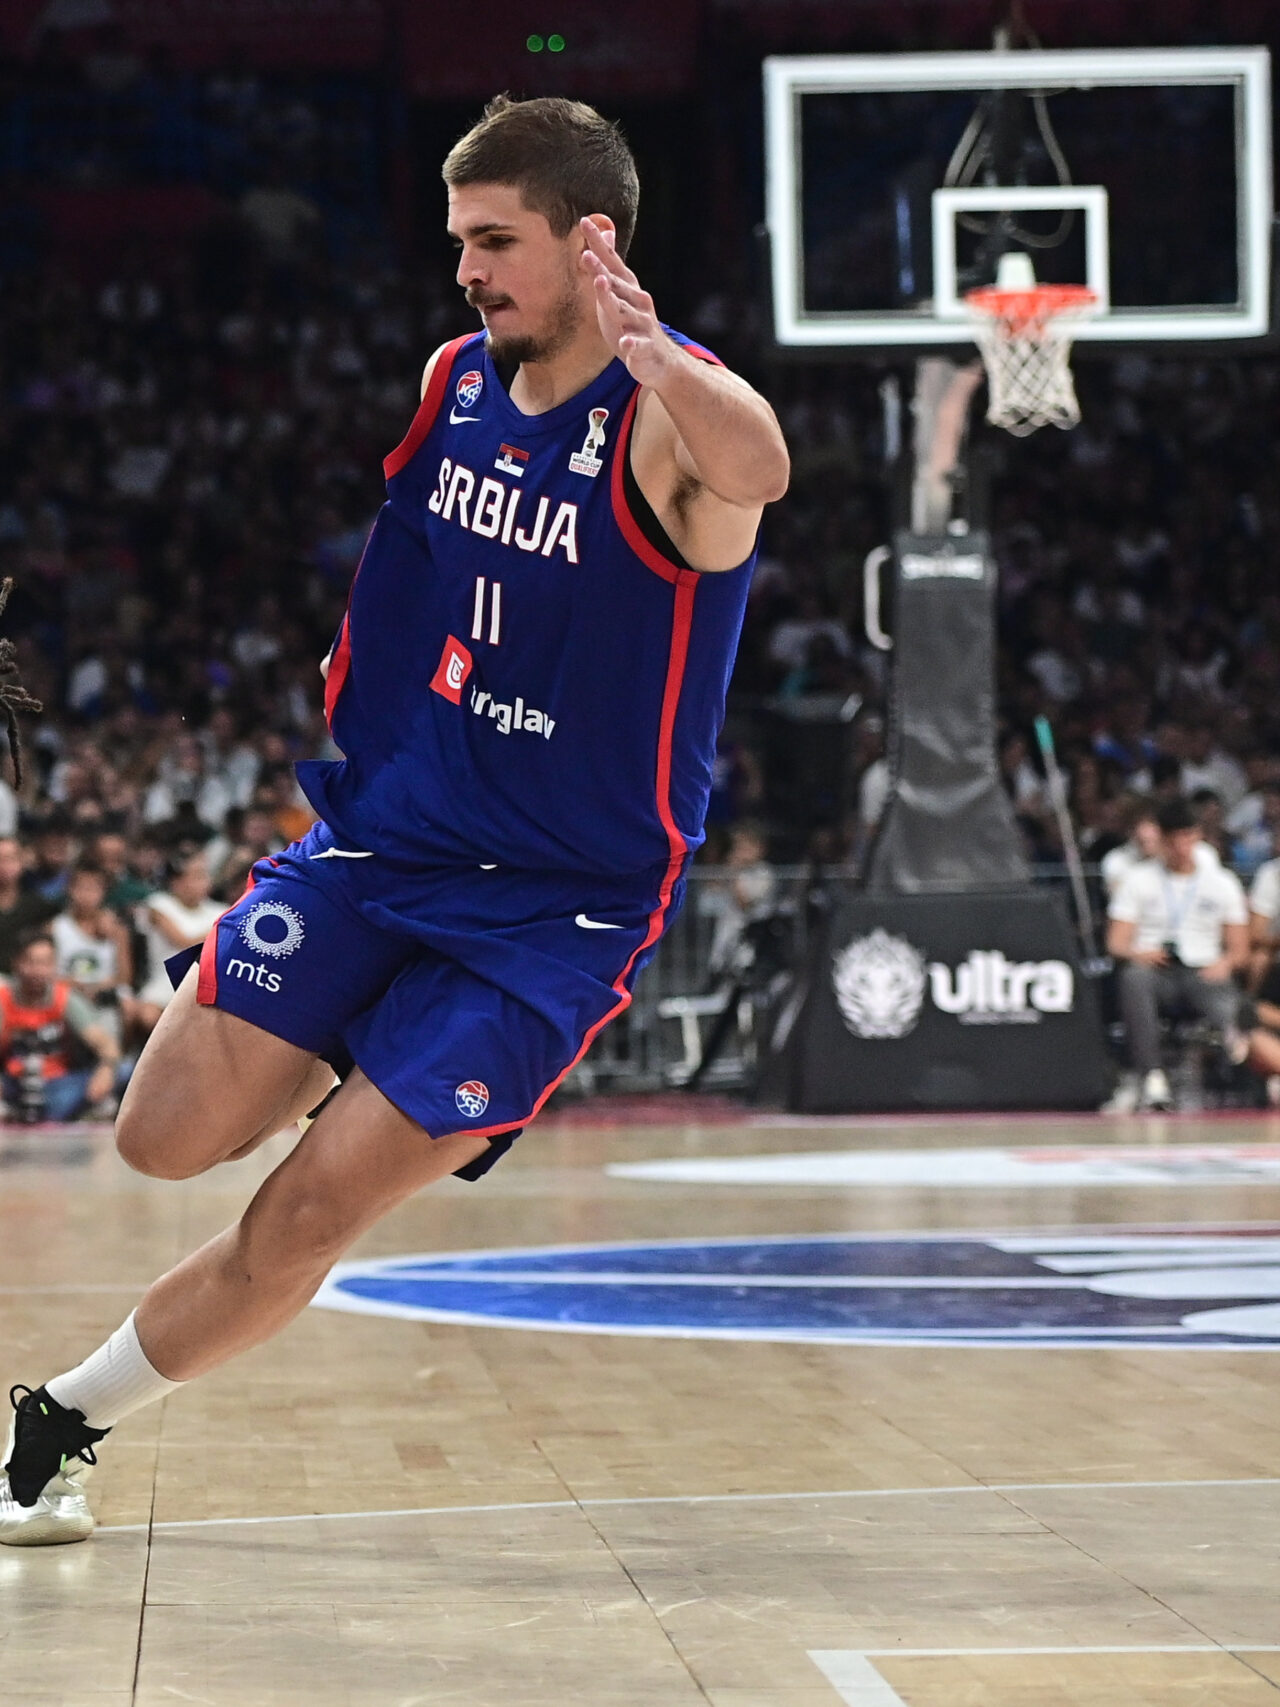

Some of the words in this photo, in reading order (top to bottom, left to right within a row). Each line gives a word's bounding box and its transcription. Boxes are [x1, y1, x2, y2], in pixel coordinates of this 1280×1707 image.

[428, 456, 580, 565] SRBIJA
[471, 576, 502, 646] 11
[226, 958, 282, 993] mts
[930, 948, 1074, 1014] ultra
